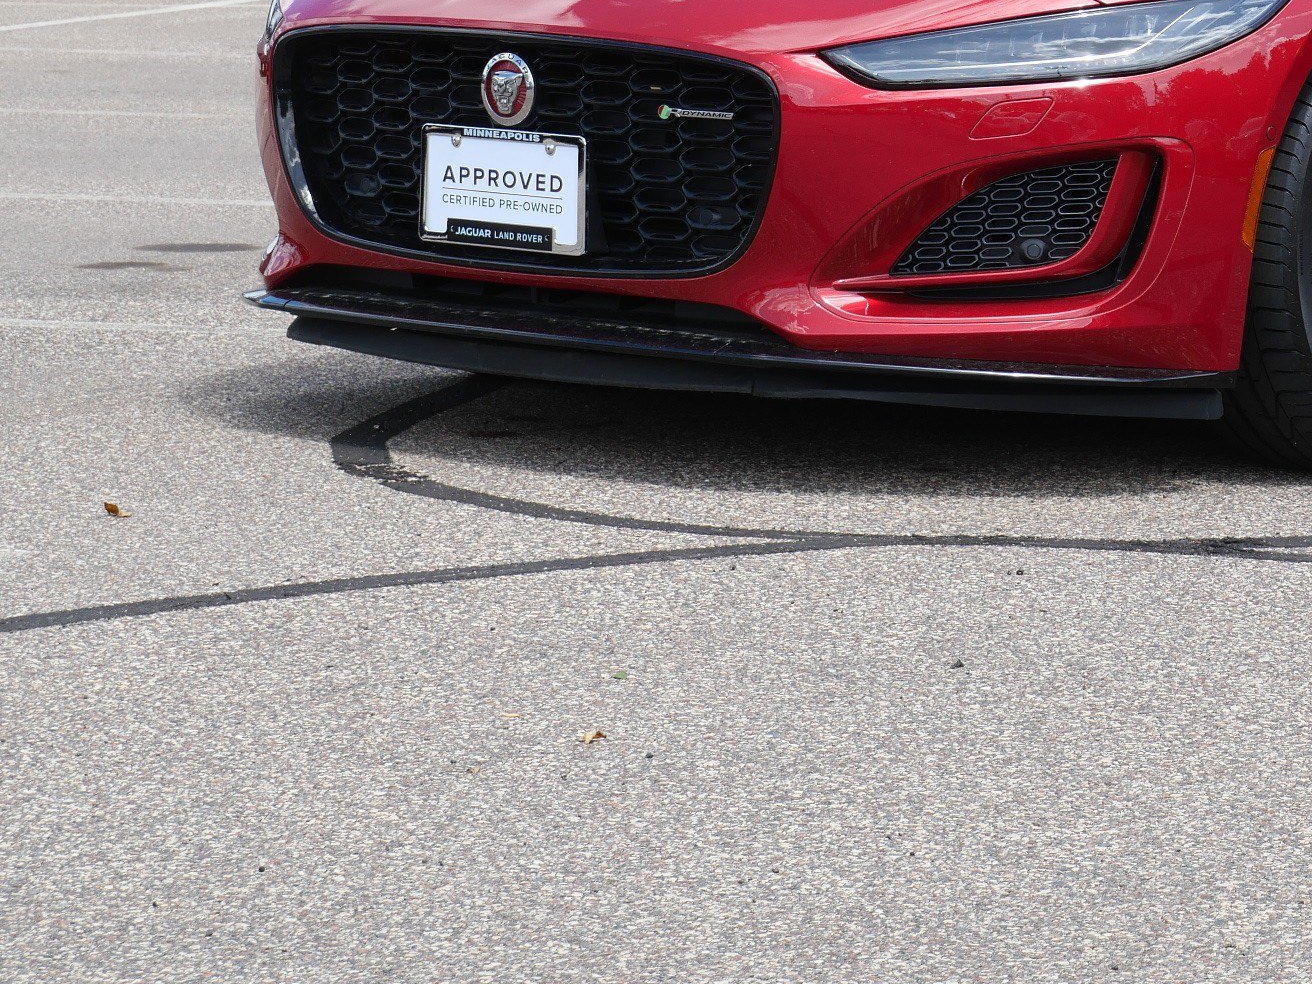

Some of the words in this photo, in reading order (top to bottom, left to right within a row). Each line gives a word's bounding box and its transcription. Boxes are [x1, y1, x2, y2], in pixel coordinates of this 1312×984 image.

[681, 110, 734, 120] DYNAMIC
[463, 128, 541, 143] MINNEAPOLIS
[442, 165, 564, 193] APPROVED
[442, 193, 495, 208] CERTIFIED
[499, 199, 563, 215] PRE-OWNED
[455, 225, 492, 238] JAGUAR
[494, 230, 515, 241] LAND
[516, 233, 543, 244] ROVER
